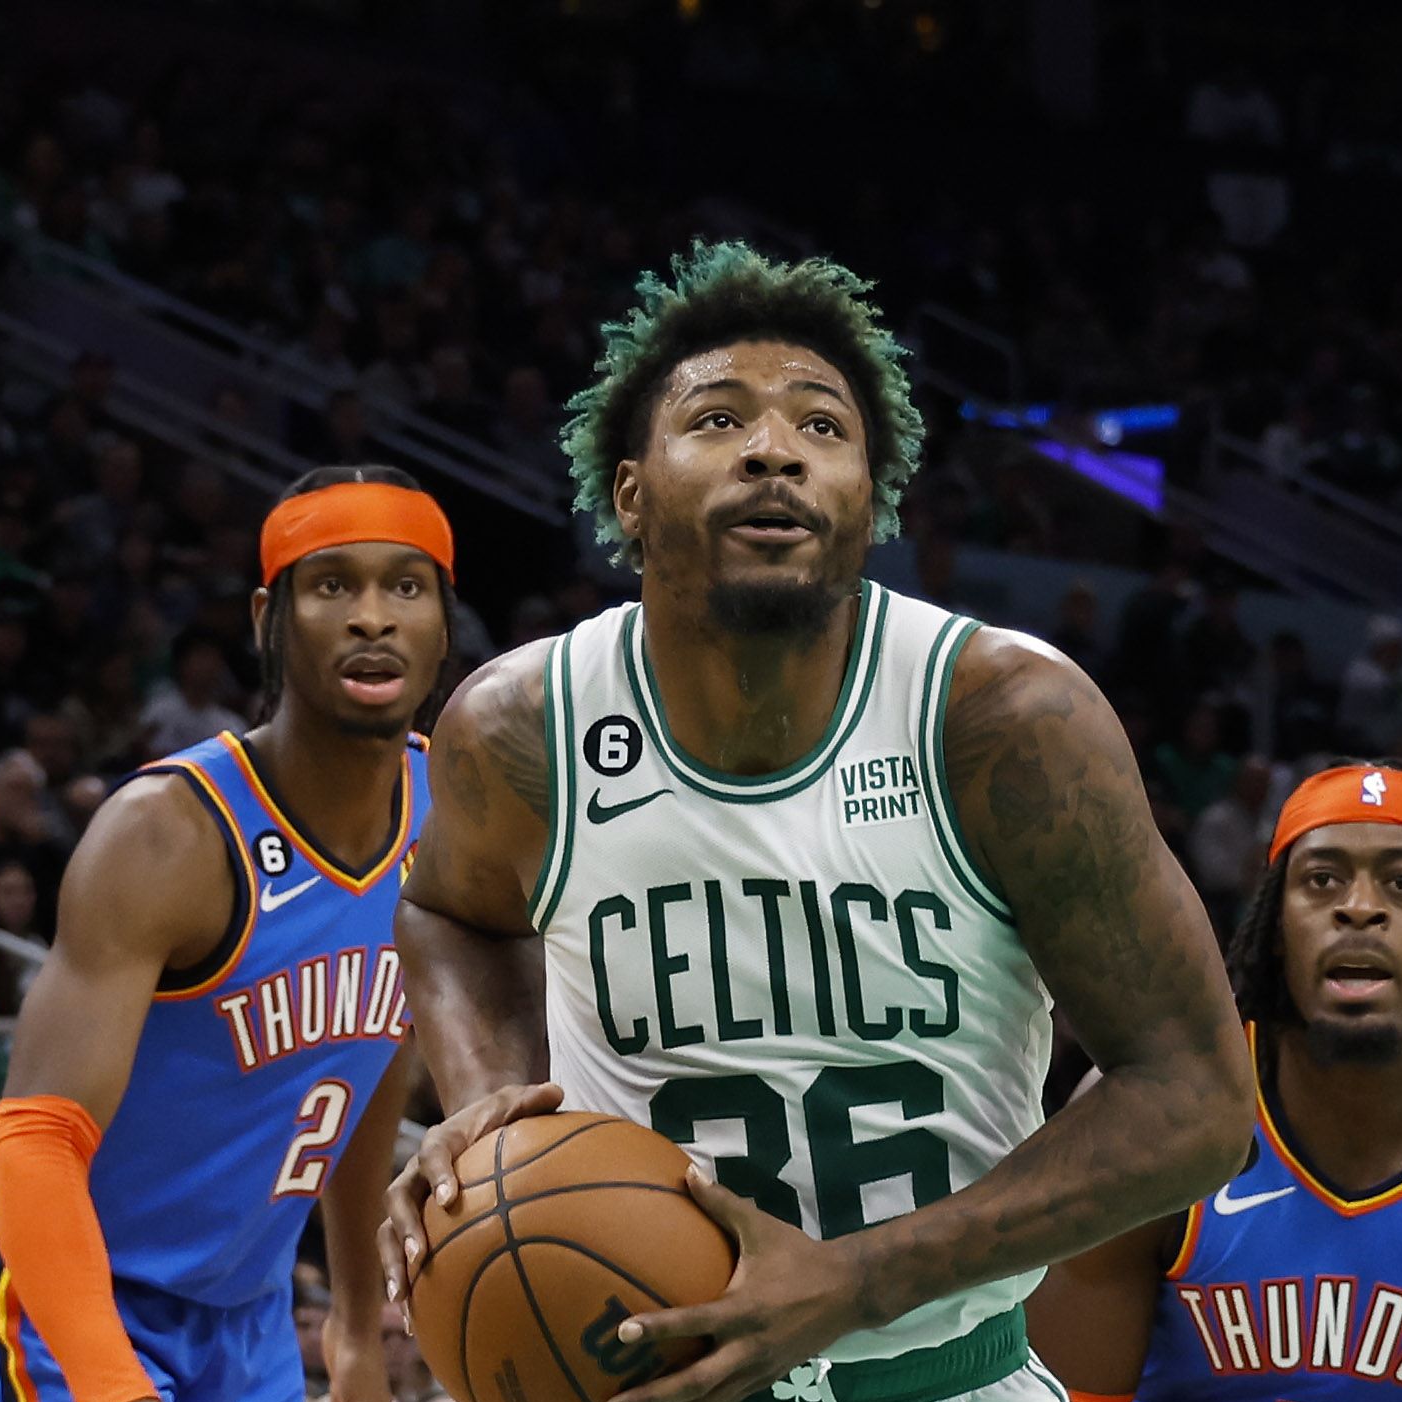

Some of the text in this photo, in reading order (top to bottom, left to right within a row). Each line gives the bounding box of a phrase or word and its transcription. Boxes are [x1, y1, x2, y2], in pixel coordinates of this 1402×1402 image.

[596, 724, 630, 769] 6
[839, 755, 919, 795] VISTA
[844, 790, 922, 824] PRINT
[258, 834, 287, 874] 6
[588, 877, 960, 1057] CELTICS
[217, 947, 409, 1071] THUND
[272, 1079, 351, 1200] 2
[648, 1060, 953, 1241] 36
